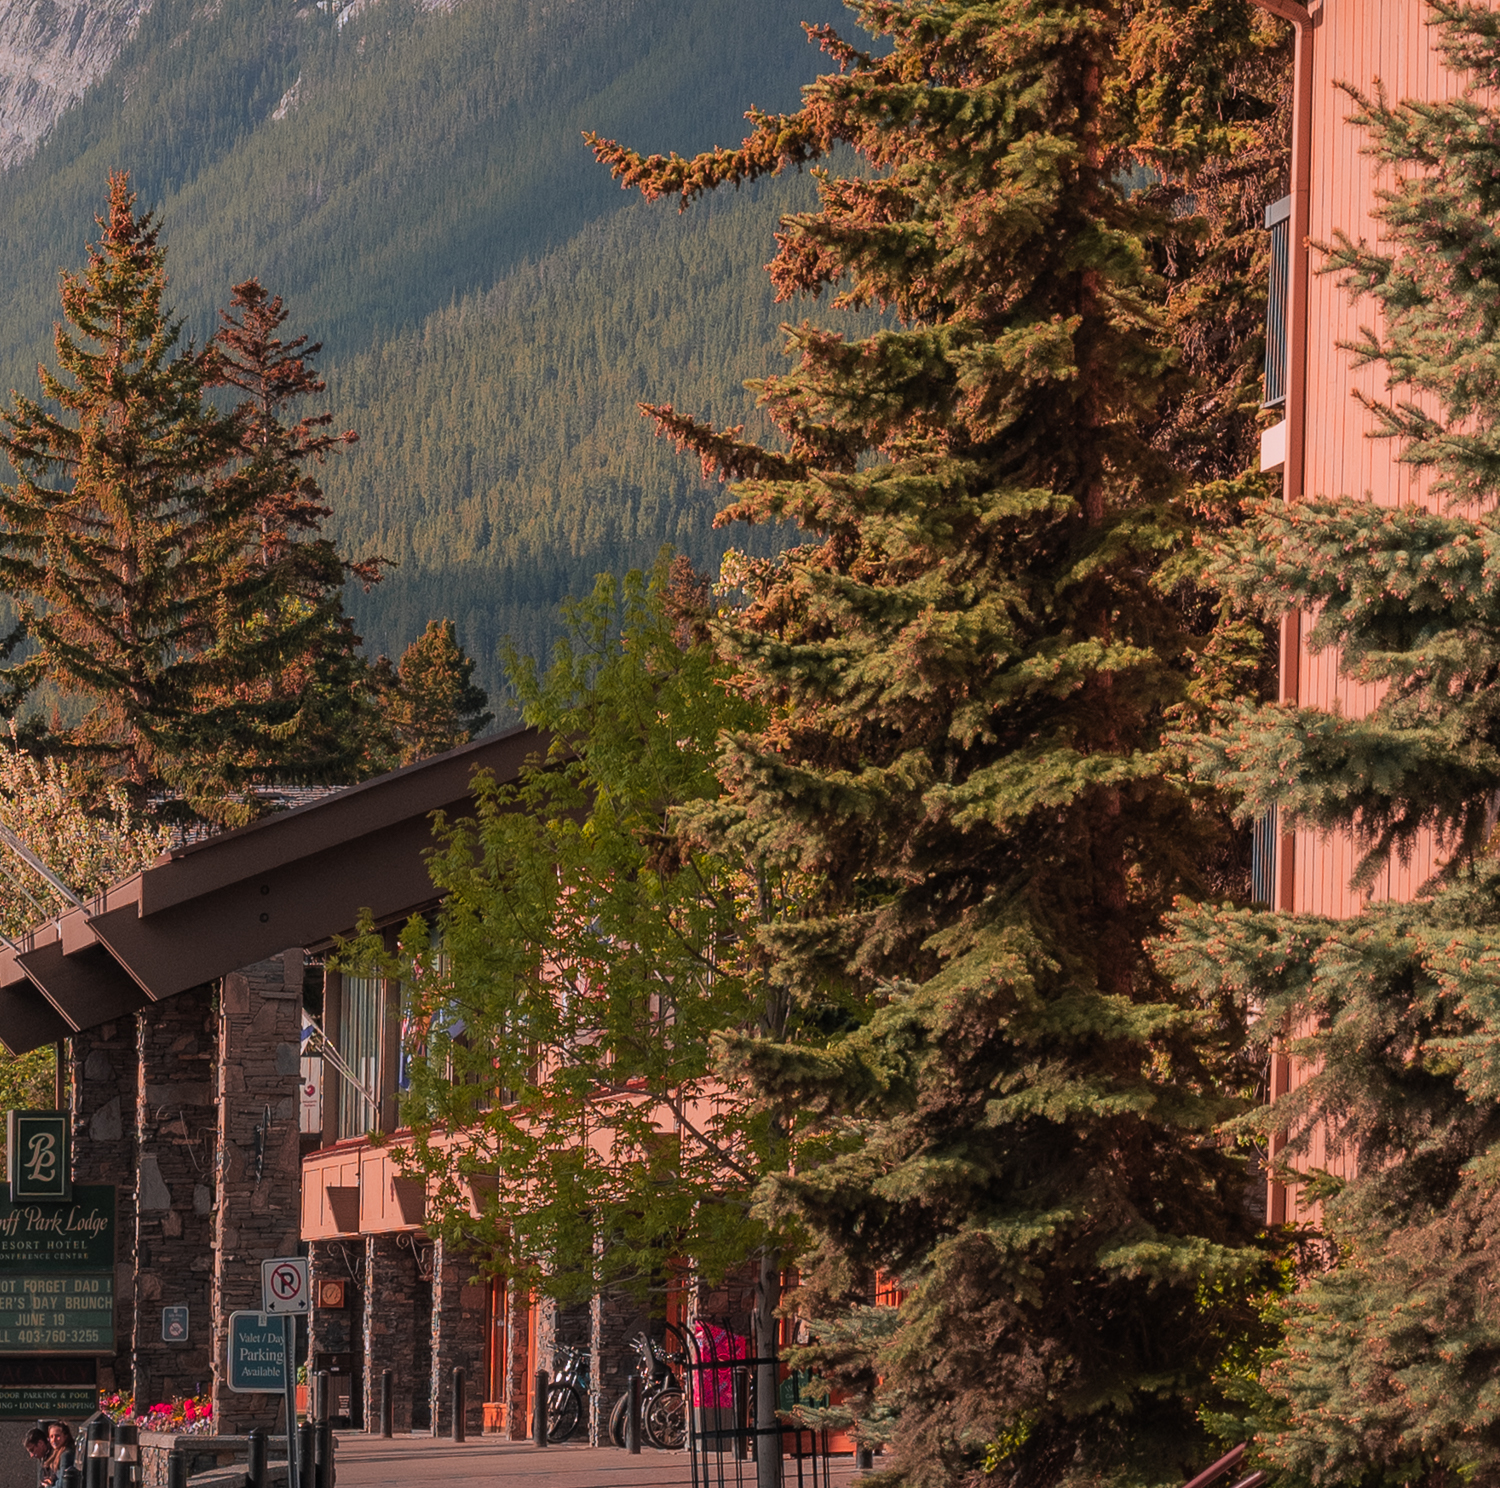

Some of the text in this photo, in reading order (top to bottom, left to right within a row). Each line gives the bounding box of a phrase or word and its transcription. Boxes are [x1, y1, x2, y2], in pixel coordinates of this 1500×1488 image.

[24, 1205, 66, 1236] Park
[65, 1205, 108, 1239] Lodge
[47, 1241, 88, 1250] HOTEL
[23, 1280, 66, 1293] FORGET
[74, 1280, 99, 1293] DAD
[33, 1297, 58, 1309] DAY
[65, 1297, 113, 1309] BRUNCH
[15, 1313, 65, 1326] JUNE 19
[18, 1329, 99, 1343] 403-760-3255
[239, 1333, 261, 1343] Valet
[268, 1333, 284, 1345] Day
[240, 1348, 284, 1365] Parking
[241, 1367, 280, 1377] Available
[19, 1402, 51, 1410] LOUNGE
[57, 1402, 95, 1410] SHOPPING
